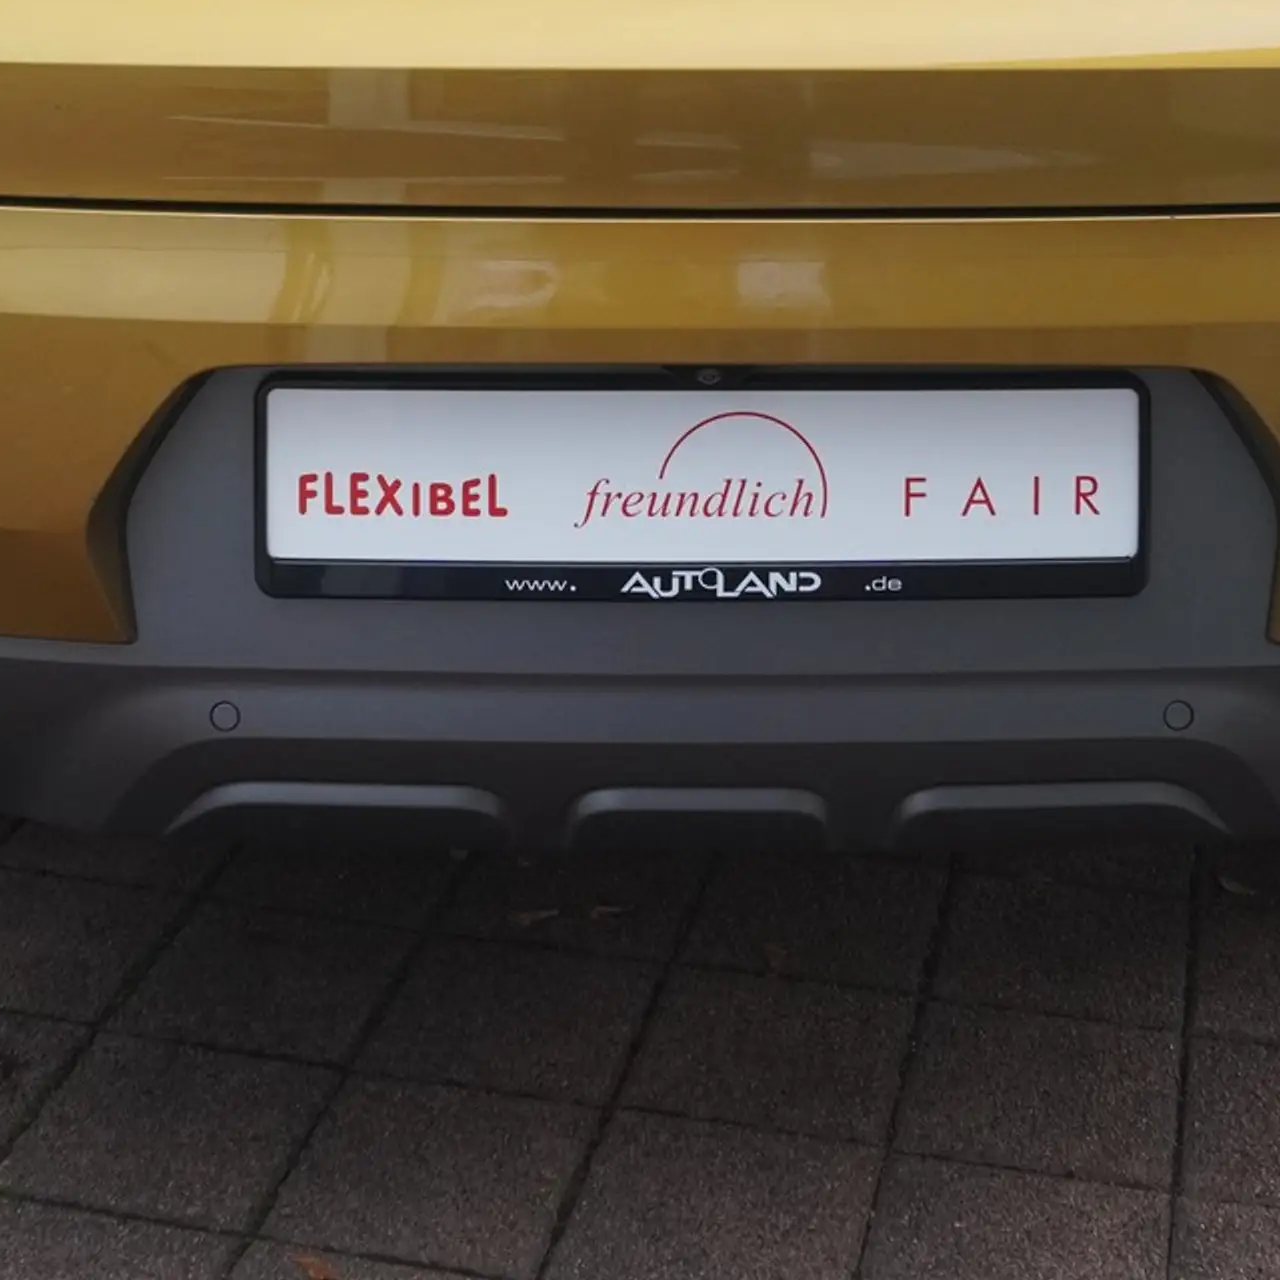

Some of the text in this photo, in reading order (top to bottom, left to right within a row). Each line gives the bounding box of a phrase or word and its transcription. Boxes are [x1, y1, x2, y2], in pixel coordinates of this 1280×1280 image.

[298, 471, 1101, 529] FLEXIBEL freundlich FAIR
[620, 567, 822, 599] AUTOLAND
[864, 575, 903, 592] .de
